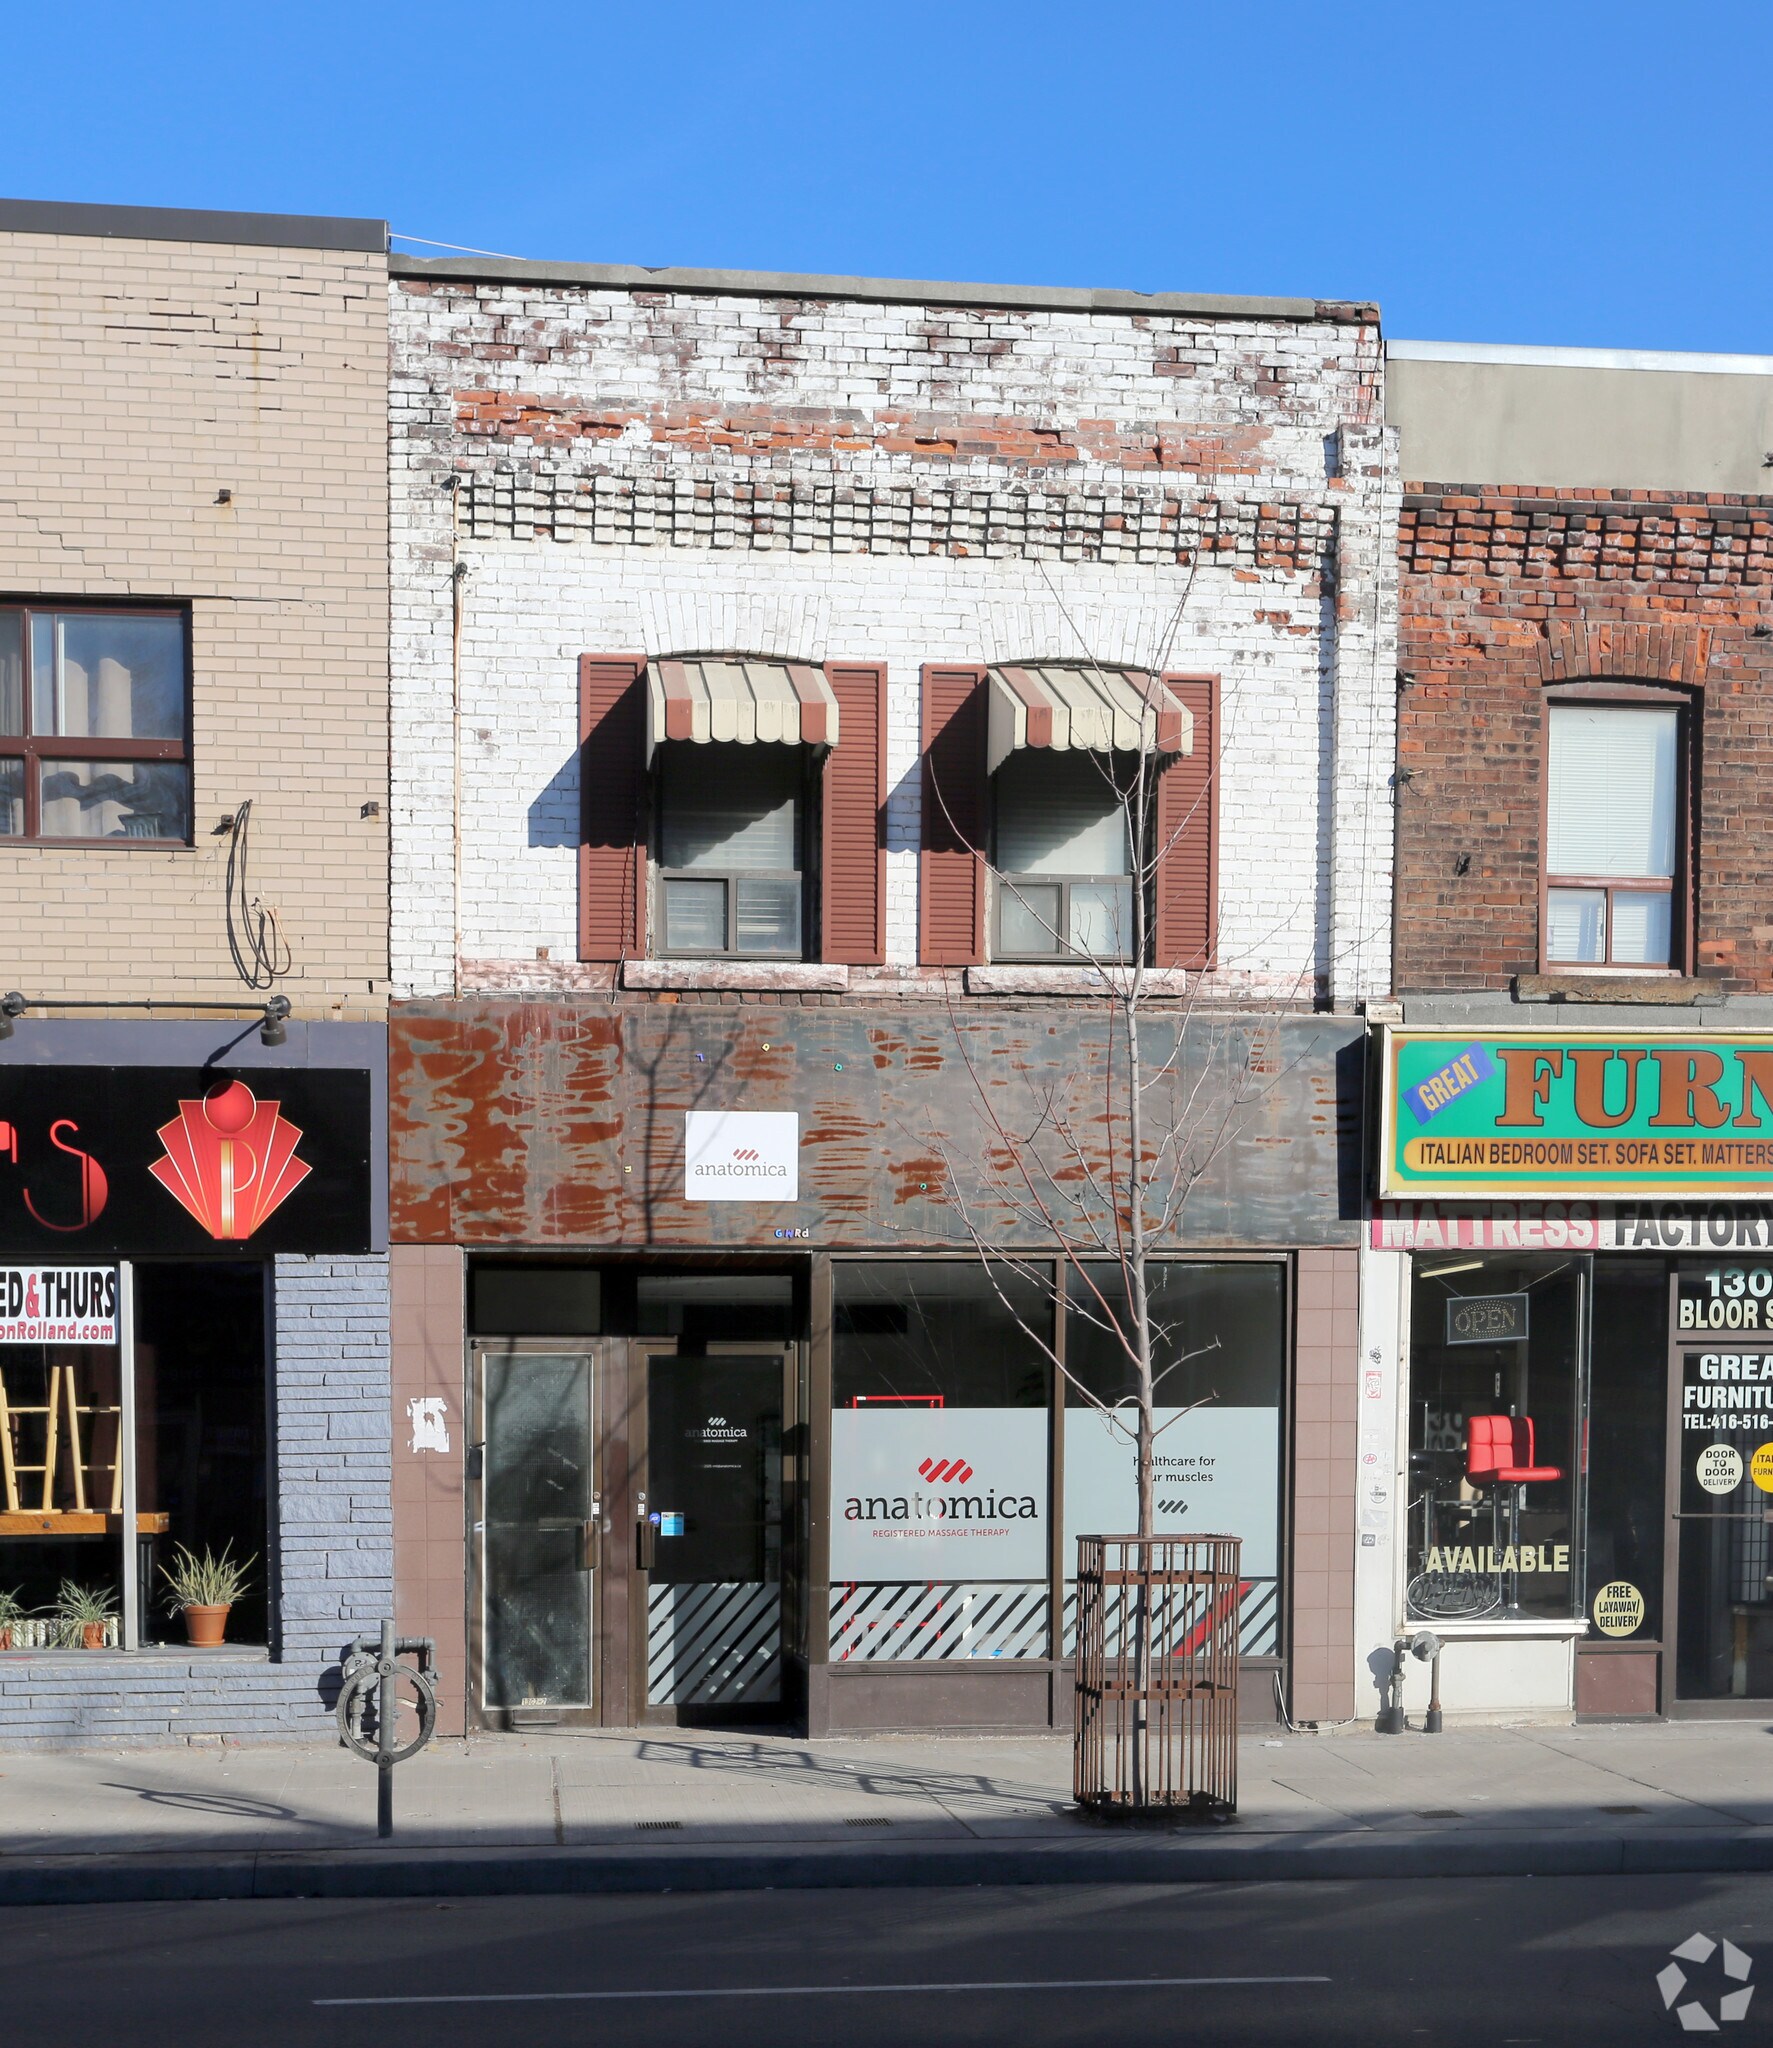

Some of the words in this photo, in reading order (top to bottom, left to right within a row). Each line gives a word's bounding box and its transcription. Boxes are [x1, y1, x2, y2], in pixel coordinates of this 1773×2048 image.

[1418, 1054, 1479, 1111] GREAT
[1495, 1049, 1773, 1129] FURN
[1420, 1143, 1485, 1164] ITALIAN
[1489, 1143, 1573, 1165] BEDROOM
[1577, 1143, 1611, 1165] SET.
[1615, 1143, 1659, 1165] SOFA
[1663, 1143, 1697, 1165] SET.
[694, 1161, 788, 1177] anatomica
[1381, 1202, 1594, 1247] MATTRESS
[1614, 1202, 1773, 1247] FACTORY
[1680, 1298, 1759, 1329] BLOOR
[1455, 1307, 1517, 1333] OPEN
[685, 1427, 747, 1438] anatomica
[1706, 1450, 1736, 1459] DOOR
[1756, 1454, 1773, 1463] ITA
[1133, 1456, 1196, 1466] hlthcare
[1200, 1456, 1216, 1466] for
[1713, 1459, 1727, 1468] TO
[1166, 1472, 1214, 1482] muscles
[1705, 1468, 1735, 1477] DOOR
[1703, 1478, 1737, 1487] DELIVERY
[844, 1489, 1039, 1521] anatomica
[873, 1530, 926, 1538] REGISTERED
[928, 1529, 968, 1537] MASSAGE
[971, 1529, 1010, 1537] THERAPY
[1425, 1545, 1570, 1573] AVAILABLE
[1607, 1586, 1631, 1598] FREE
[1599, 1599, 1640, 1614] LAYAWAY/
[1600, 1616, 1638, 1627] DELIVERY
